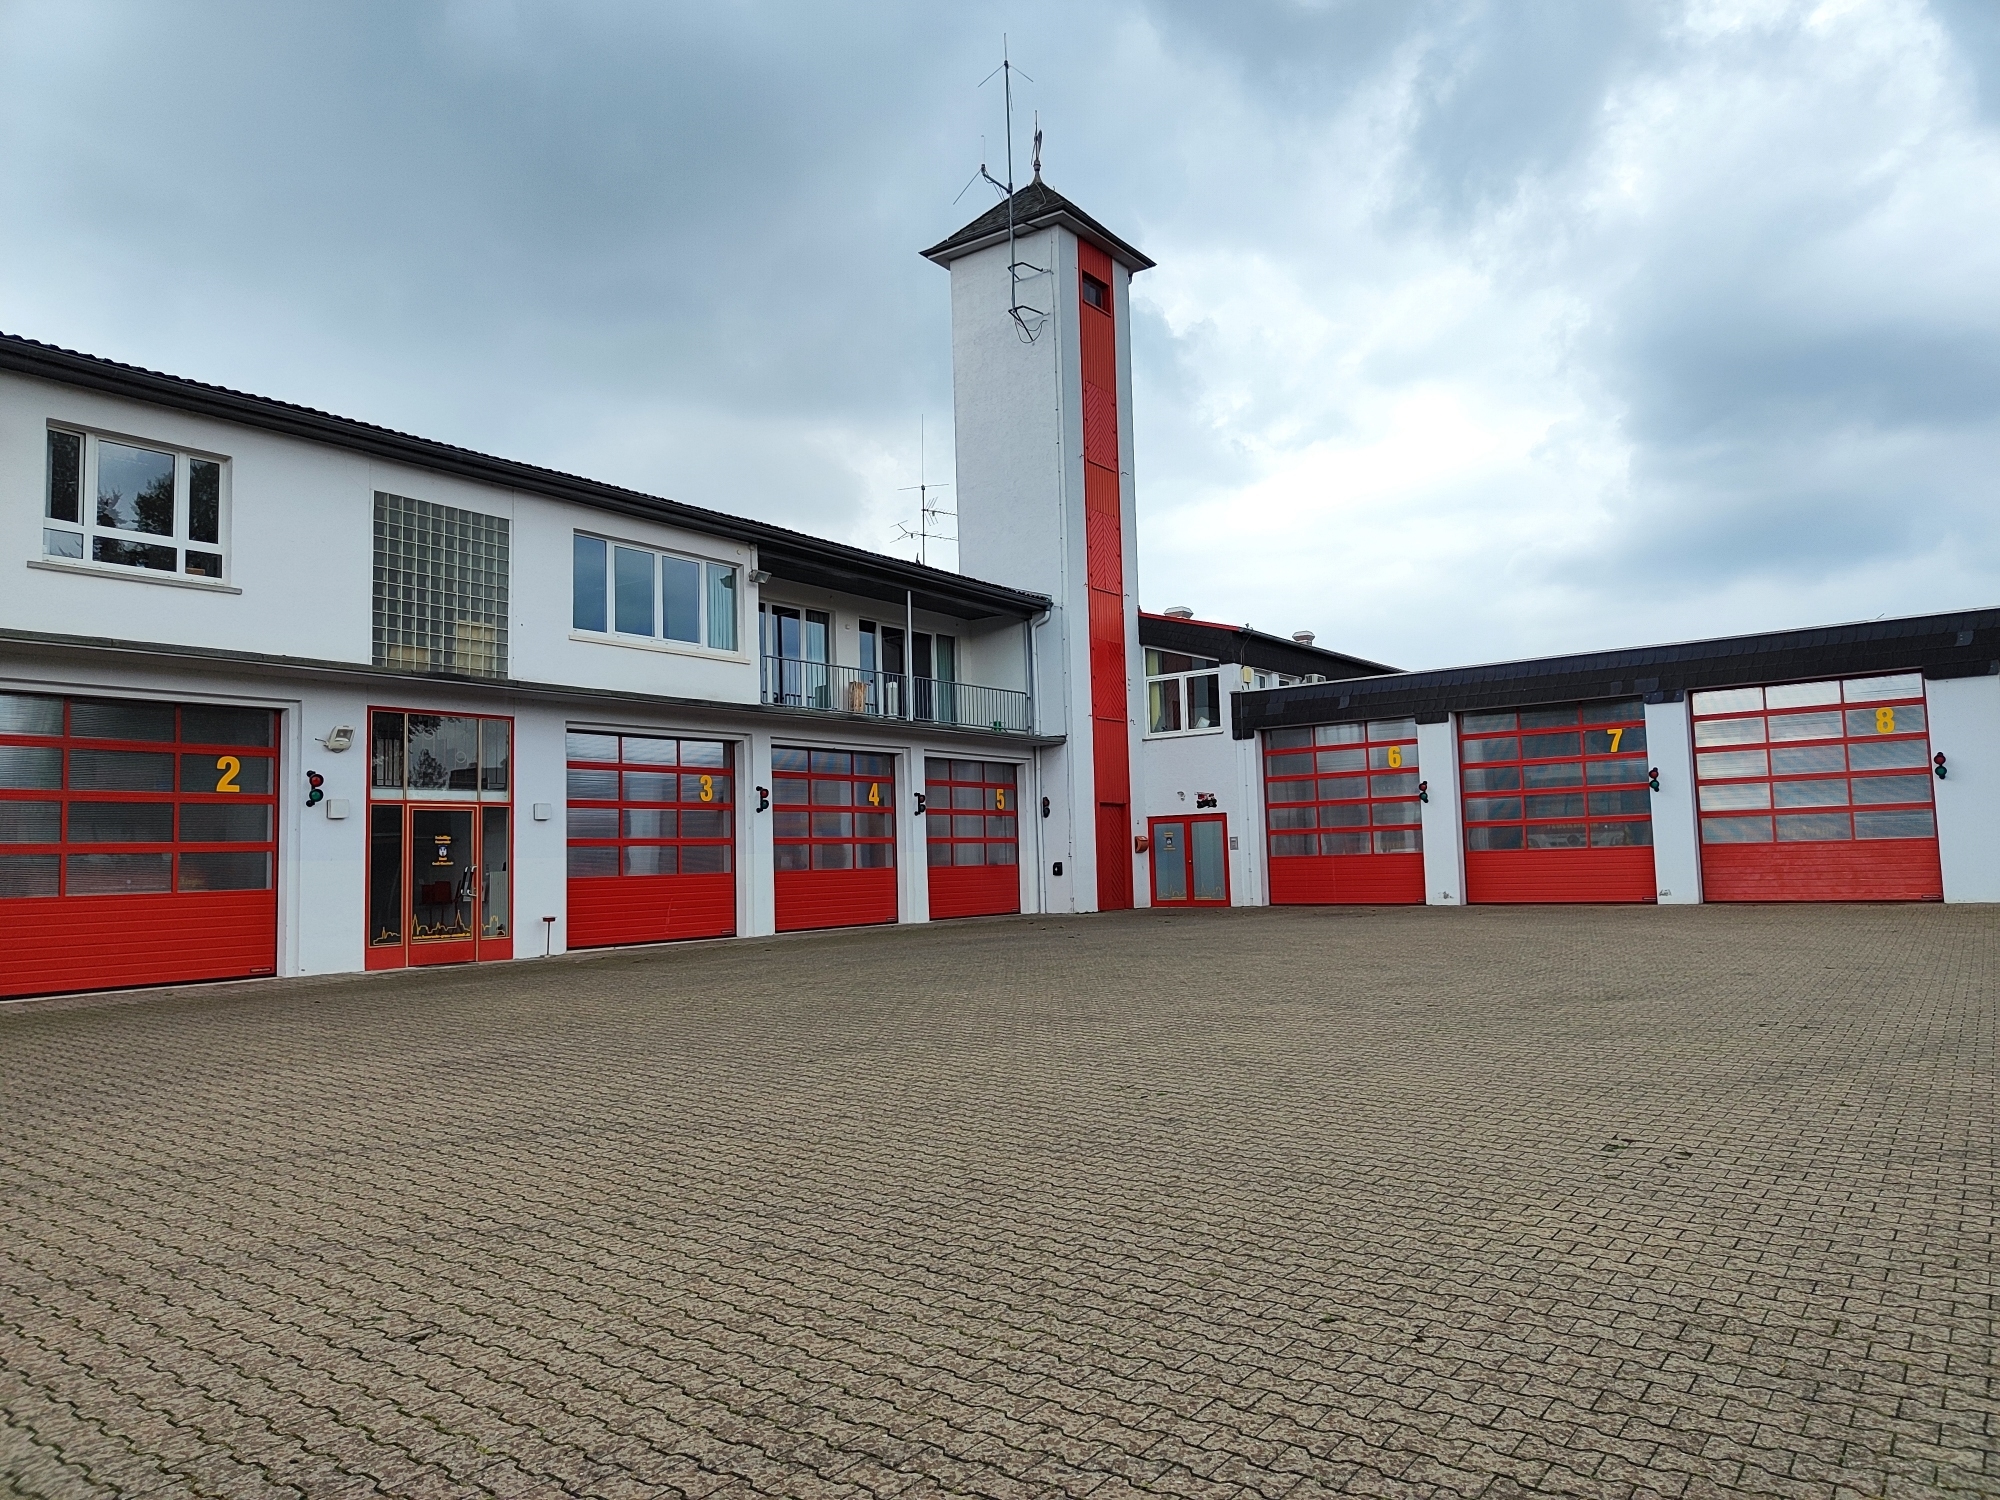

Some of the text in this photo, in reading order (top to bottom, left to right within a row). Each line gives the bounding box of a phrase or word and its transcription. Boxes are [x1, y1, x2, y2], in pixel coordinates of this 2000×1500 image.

[1876, 707, 1895, 734] 8
[1607, 729, 1623, 752] 7
[1387, 746, 1402, 768] 6
[215, 756, 241, 792] 2
[700, 775, 713, 802] 3
[868, 783, 880, 806] 4
[996, 789, 1005, 809] 5
